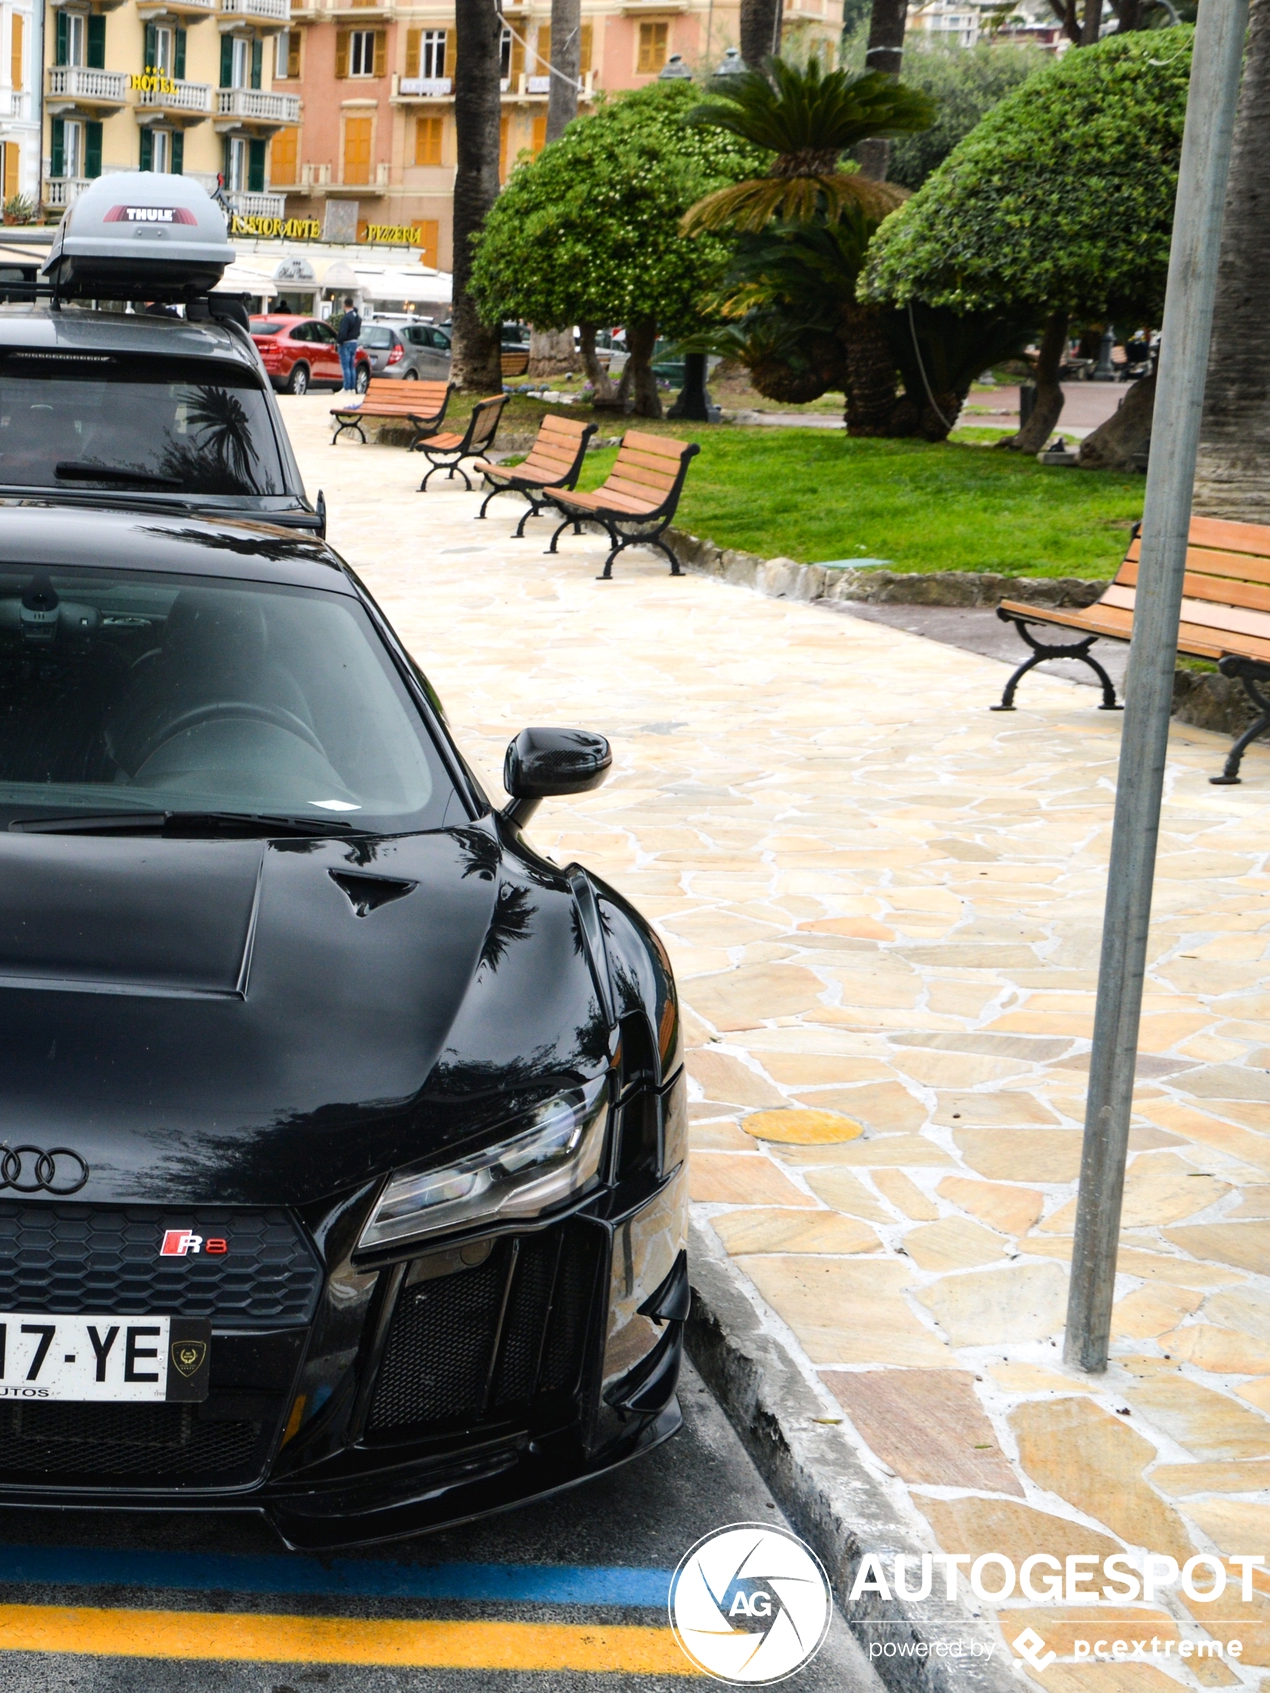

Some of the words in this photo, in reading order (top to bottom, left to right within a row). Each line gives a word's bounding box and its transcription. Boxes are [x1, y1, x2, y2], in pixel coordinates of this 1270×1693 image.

[131, 74, 179, 95] HOTEL
[126, 208, 173, 222] THULE
[231, 215, 320, 239] RISTORANTE
[367, 224, 422, 244] PIZZERIA
[176, 1235, 228, 1254] R8
